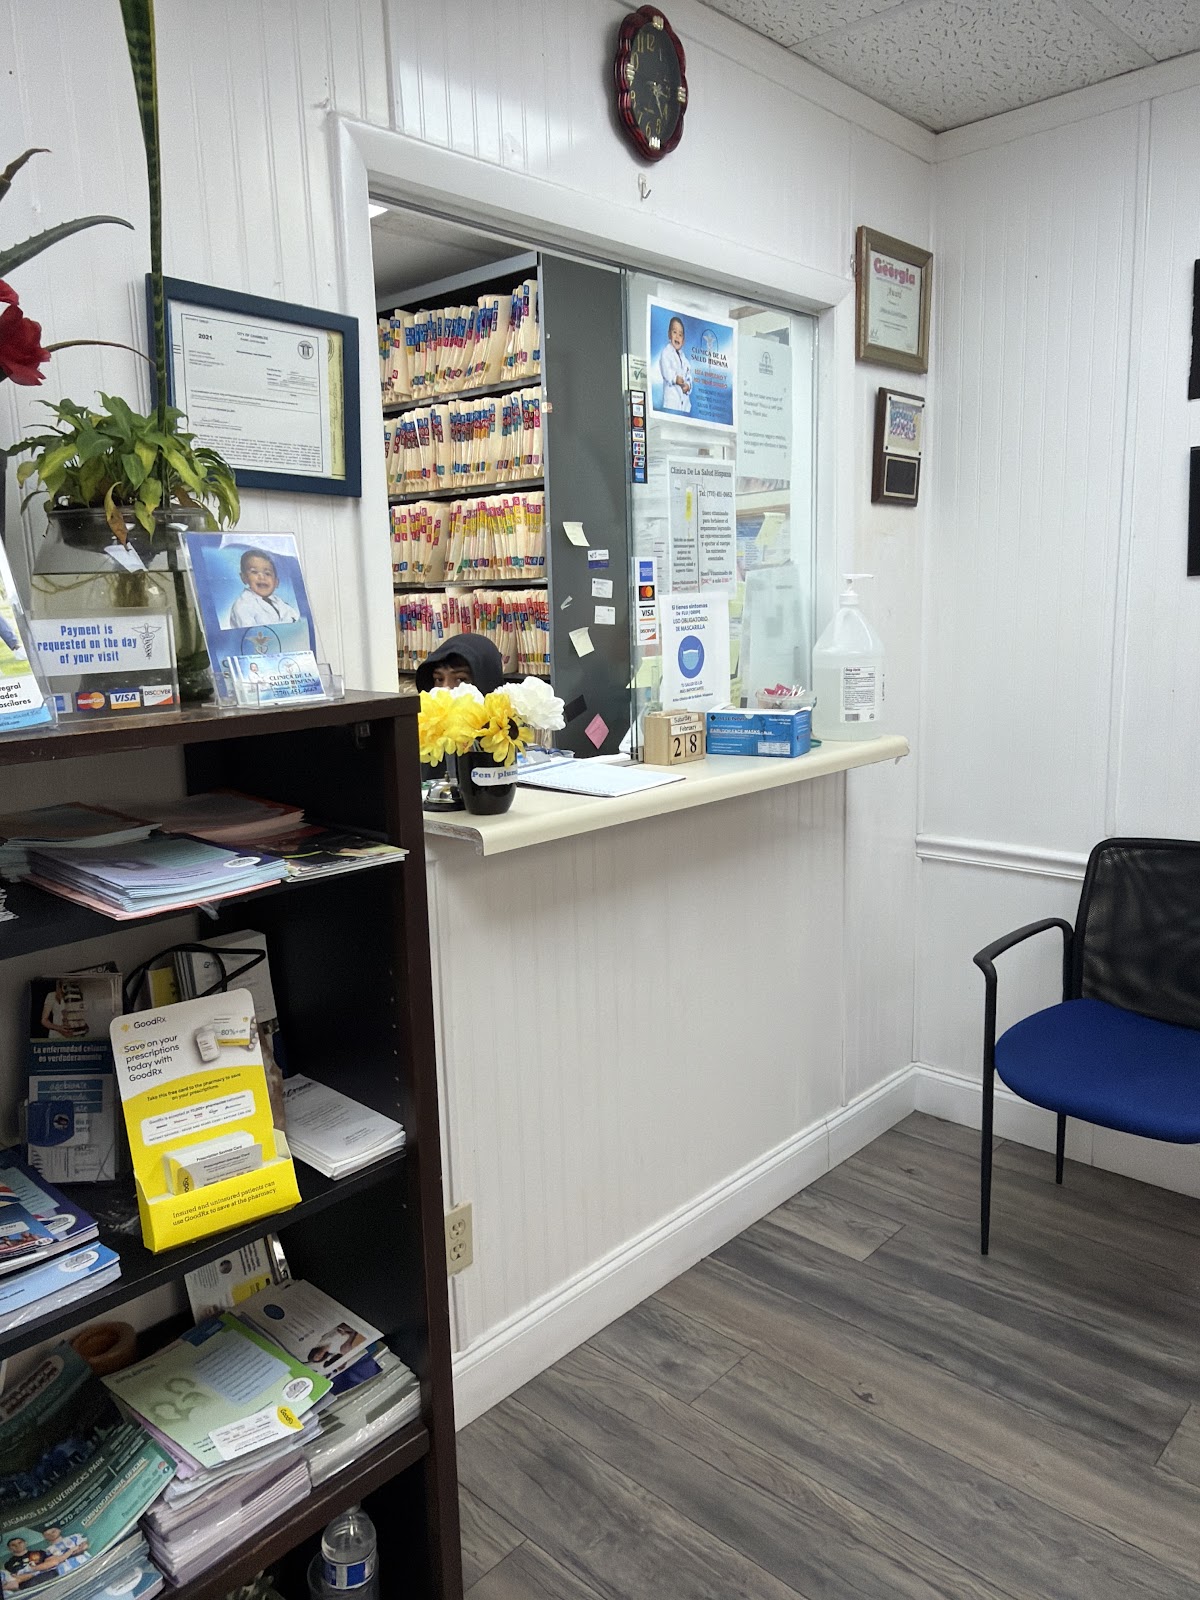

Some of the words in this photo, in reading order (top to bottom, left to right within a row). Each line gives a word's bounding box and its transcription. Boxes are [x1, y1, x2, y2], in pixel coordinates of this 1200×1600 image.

[874, 258, 916, 285] Georgia
[198, 333, 213, 341] 2021
[694, 468, 701, 476] La
[60, 624, 101, 638] Payment
[104, 624, 113, 635] is
[38, 639, 86, 652] requested
[90, 639, 101, 649] on
[104, 638, 119, 648] the
[122, 637, 137, 649] day
[60, 654, 70, 664] of
[73, 654, 95, 665] your
[98, 651, 119, 662] visit
[291, 678, 316, 686] HISPANA
[114, 694, 137, 703] VISA
[674, 715, 692, 723] Saturday
[680, 725, 697, 733] February
[134, 1016, 167, 1029] GoodRx
[33, 1046, 42, 1054] La
[42, 1045, 83, 1054] enfermedad
[124, 1044, 146, 1053] Save
[147, 1040, 158, 1048] on
[159, 1035, 178, 1047] your
[126, 1045, 180, 1065] prescriptions
[128, 1061, 153, 1073] today
[154, 1055, 173, 1066] with
[129, 1068, 163, 1082] GoodRx
[178, 1086, 189, 1094] card
[203, 1077, 225, 1087] pharmacy
[178, 1092, 189, 1100] your
[172, 1206, 197, 1219] Insured
[198, 1202, 210, 1211] and
[210, 1192, 241, 1207] uninsured
[241, 1184, 264, 1198] patients
[172, 1218, 184, 1226] use
[184, 1211, 210, 1222] GoodRx
[237, 1197, 248, 1205] the
[248, 1188, 277, 1202] pharmacy
[2, 1512, 37, 1529] JUGAMOS
[37, 1506, 48, 1516] EN
[47, 1472, 89, 1510] SILVERBACKS
[88, 1456, 106, 1475] PARK
[80, 1480, 126, 1526] CONVOCATORIA
[125, 1457, 148, 1481] OFICIAL
